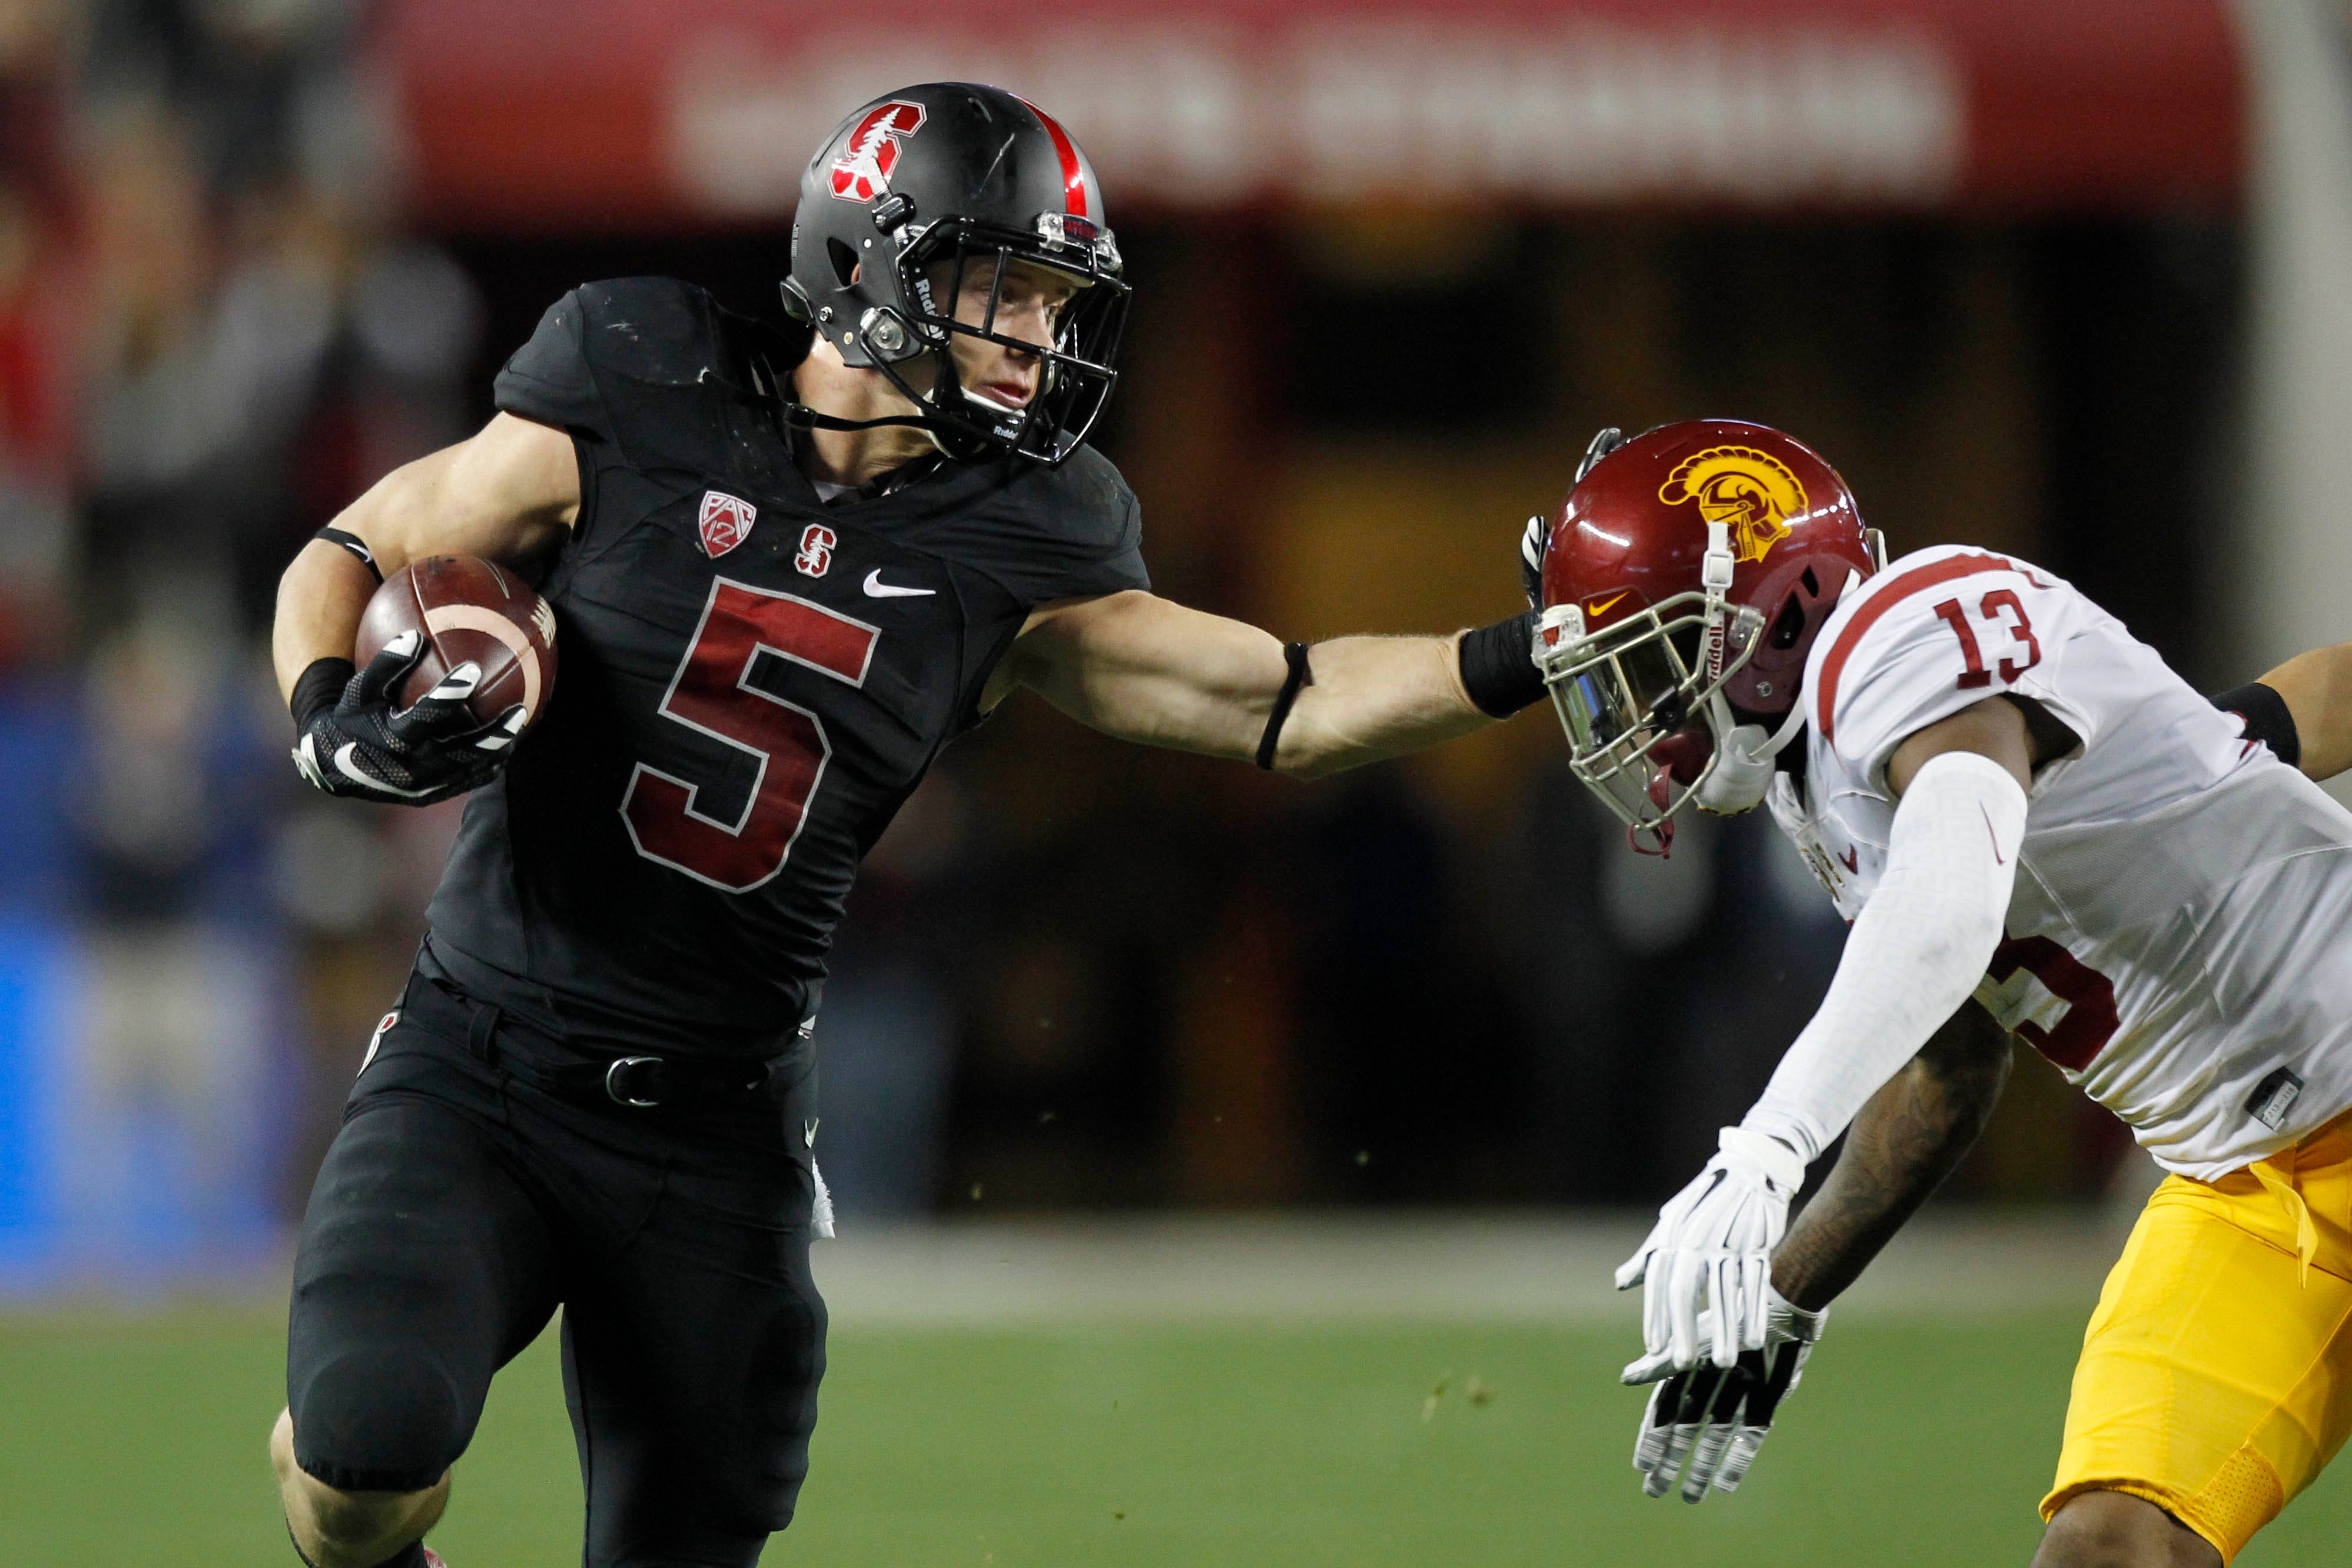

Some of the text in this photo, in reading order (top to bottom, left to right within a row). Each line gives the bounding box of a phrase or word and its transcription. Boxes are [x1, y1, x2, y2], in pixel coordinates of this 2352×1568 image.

[915, 278, 946, 340] Ridel
[703, 495, 754, 540] PAC
[706, 520, 736, 548] 12
[1933, 589, 2041, 690] 13
[617, 574, 883, 895] 5
